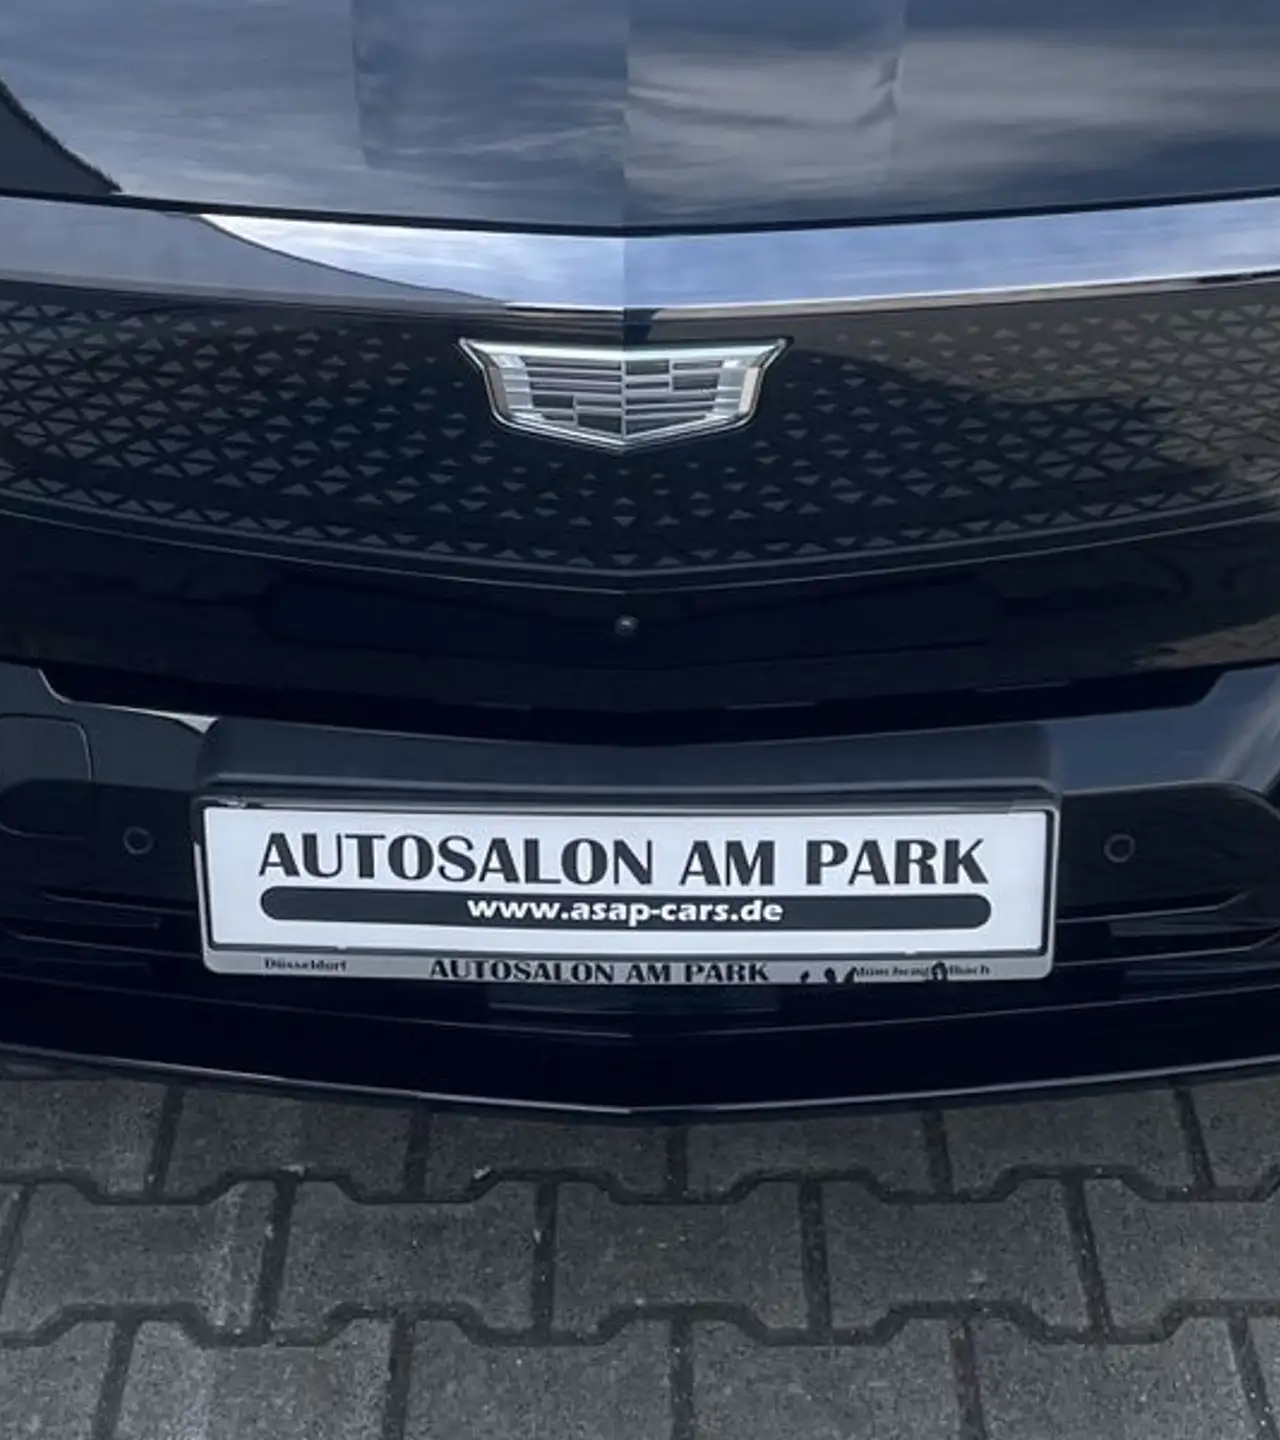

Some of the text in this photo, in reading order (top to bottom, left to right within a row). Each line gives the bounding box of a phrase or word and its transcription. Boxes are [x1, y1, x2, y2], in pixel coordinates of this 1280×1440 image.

[258, 832, 989, 886] AUTOSALON AM PARK
[467, 899, 783, 927] www.asap-cars.de
[429, 958, 770, 983] AUTOSALON AM PARK
